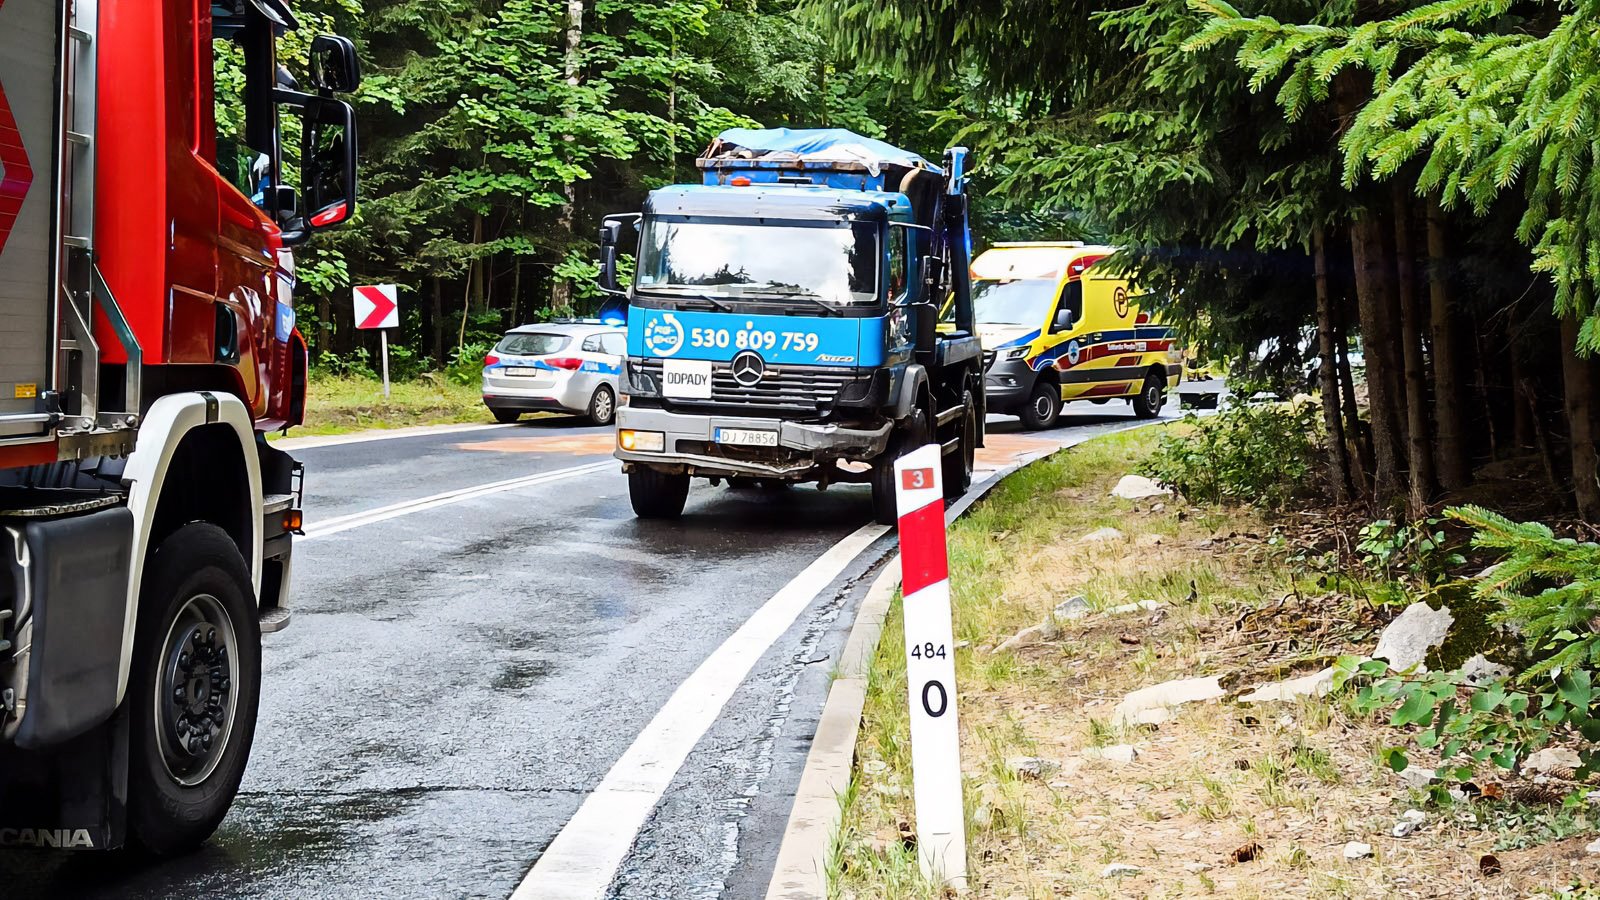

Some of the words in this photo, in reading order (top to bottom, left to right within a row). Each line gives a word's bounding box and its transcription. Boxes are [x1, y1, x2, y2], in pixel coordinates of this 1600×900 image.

[691, 328, 730, 348] 530
[735, 329, 776, 350] 809
[781, 332, 819, 352] 759
[667, 372, 708, 386] ODPADY
[722, 431, 737, 442] DJ
[741, 432, 775, 444] 78856
[912, 470, 924, 488] 3
[911, 642, 946, 660] 484
[922, 680, 948, 718] 0
